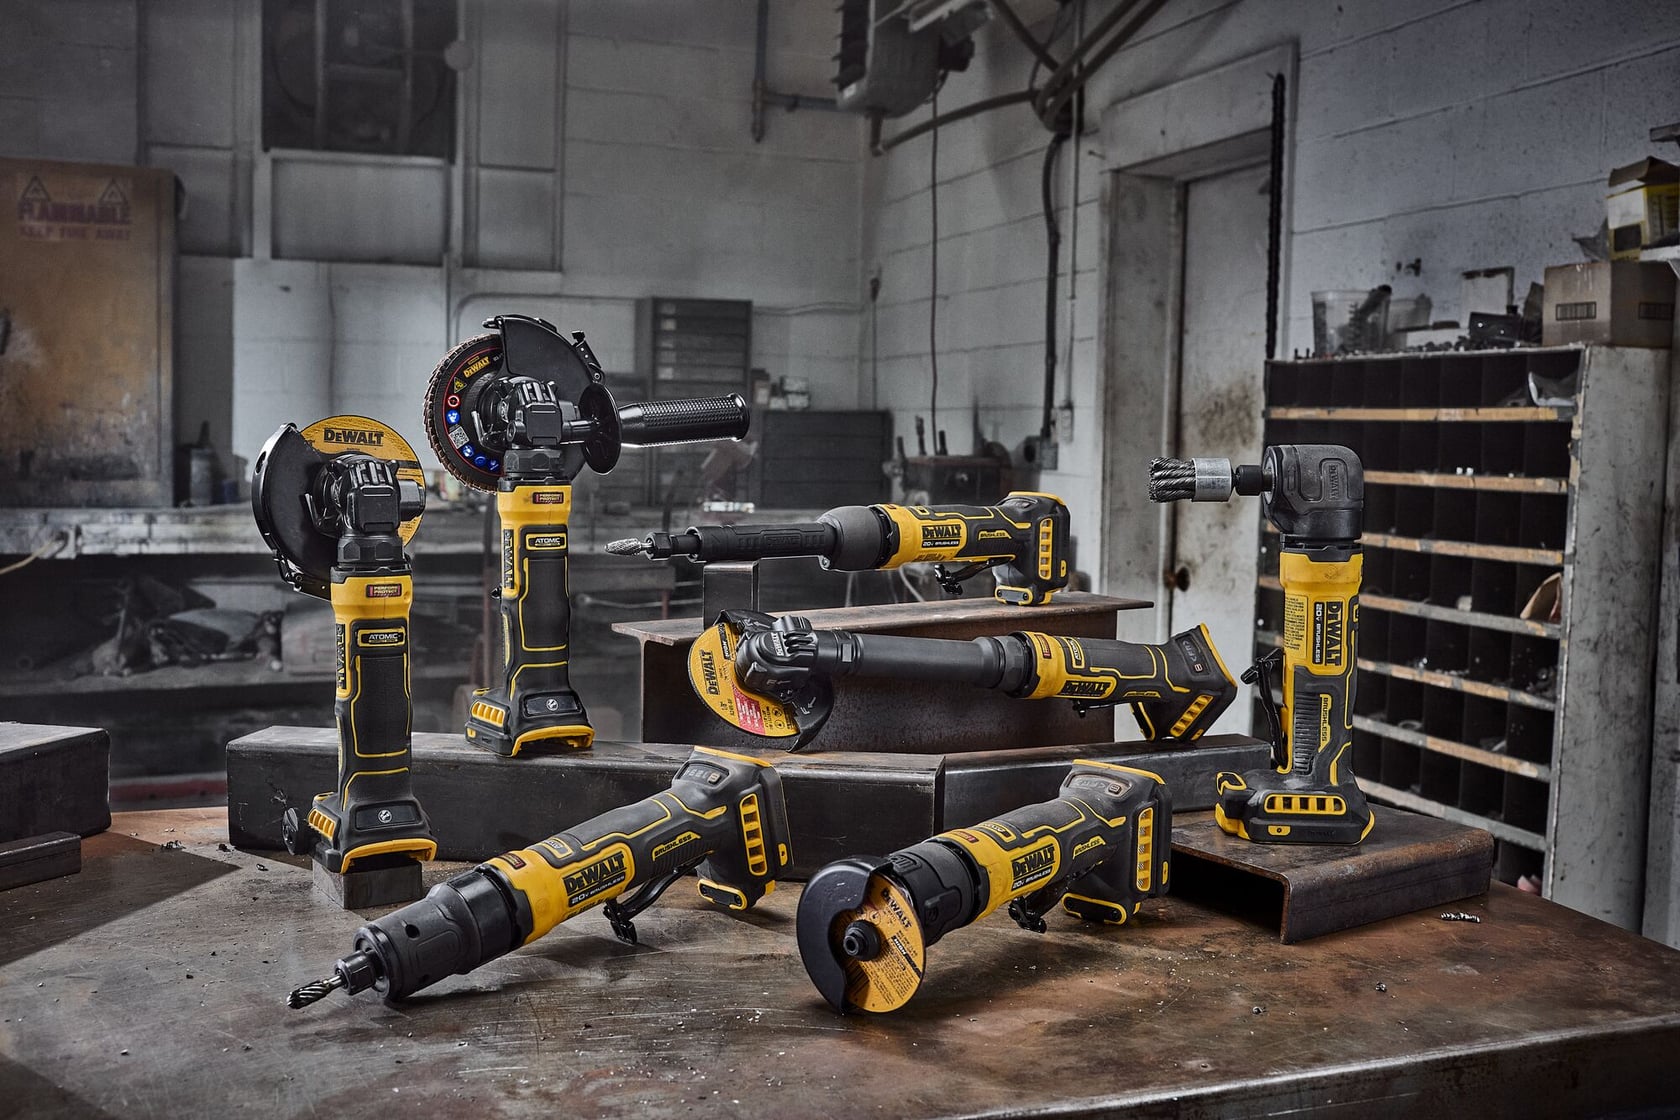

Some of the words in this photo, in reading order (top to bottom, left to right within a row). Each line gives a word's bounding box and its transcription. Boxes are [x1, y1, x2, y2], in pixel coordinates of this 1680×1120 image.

[323, 428, 385, 446] DEWALT
[922, 525, 962, 539] DEWALT
[369, 632, 399, 640] ATOMIC
[1326, 602, 1343, 666] DEWALT
[701, 649, 719, 695] DEWALT
[654, 834, 692, 857] BRUSHLESS
[564, 853, 627, 893] DEWALT
[1012, 845, 1056, 879] DEWALT
